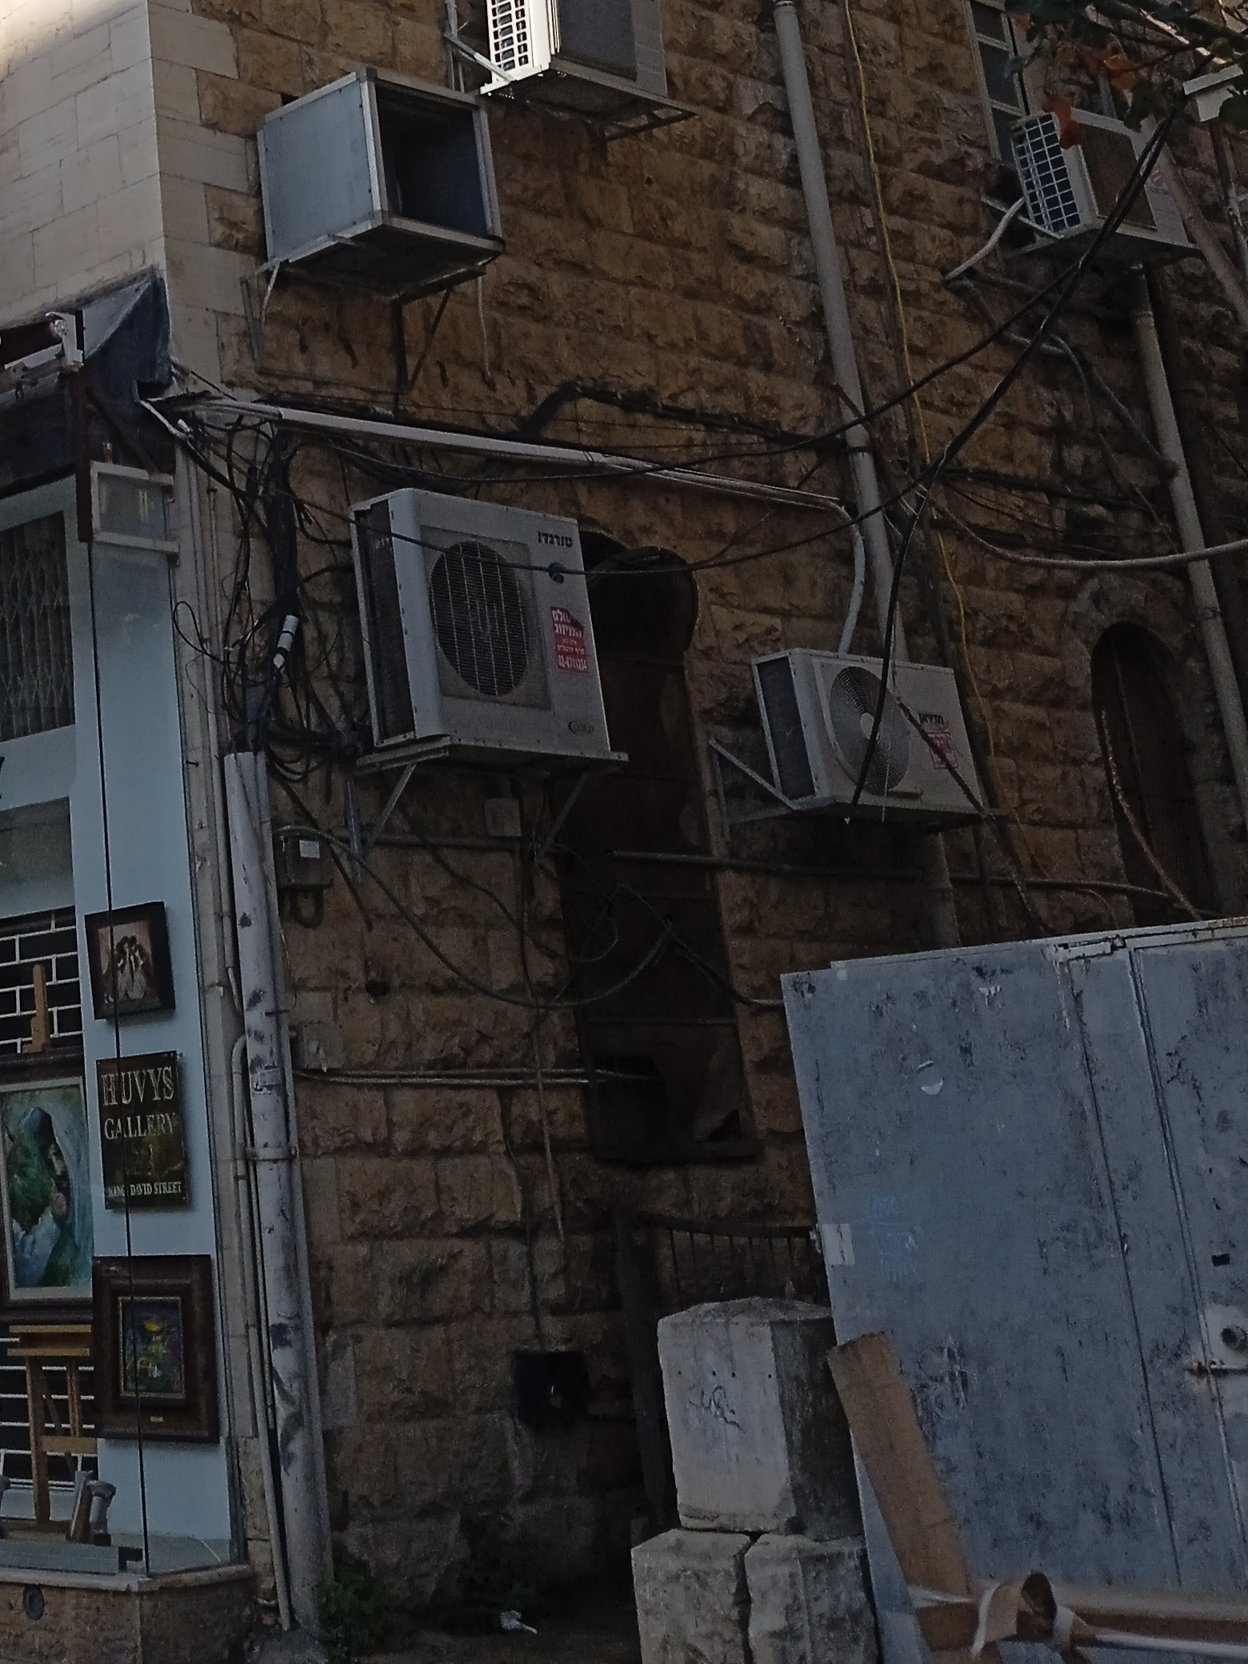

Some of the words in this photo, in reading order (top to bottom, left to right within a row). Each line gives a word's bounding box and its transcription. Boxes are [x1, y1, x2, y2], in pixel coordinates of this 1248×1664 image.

[101, 1065, 175, 1106] HUVYS
[104, 1112, 177, 1140] GALLERY
[130, 1182, 153, 1196] DAVID
[153, 1181, 182, 1195] STREET
